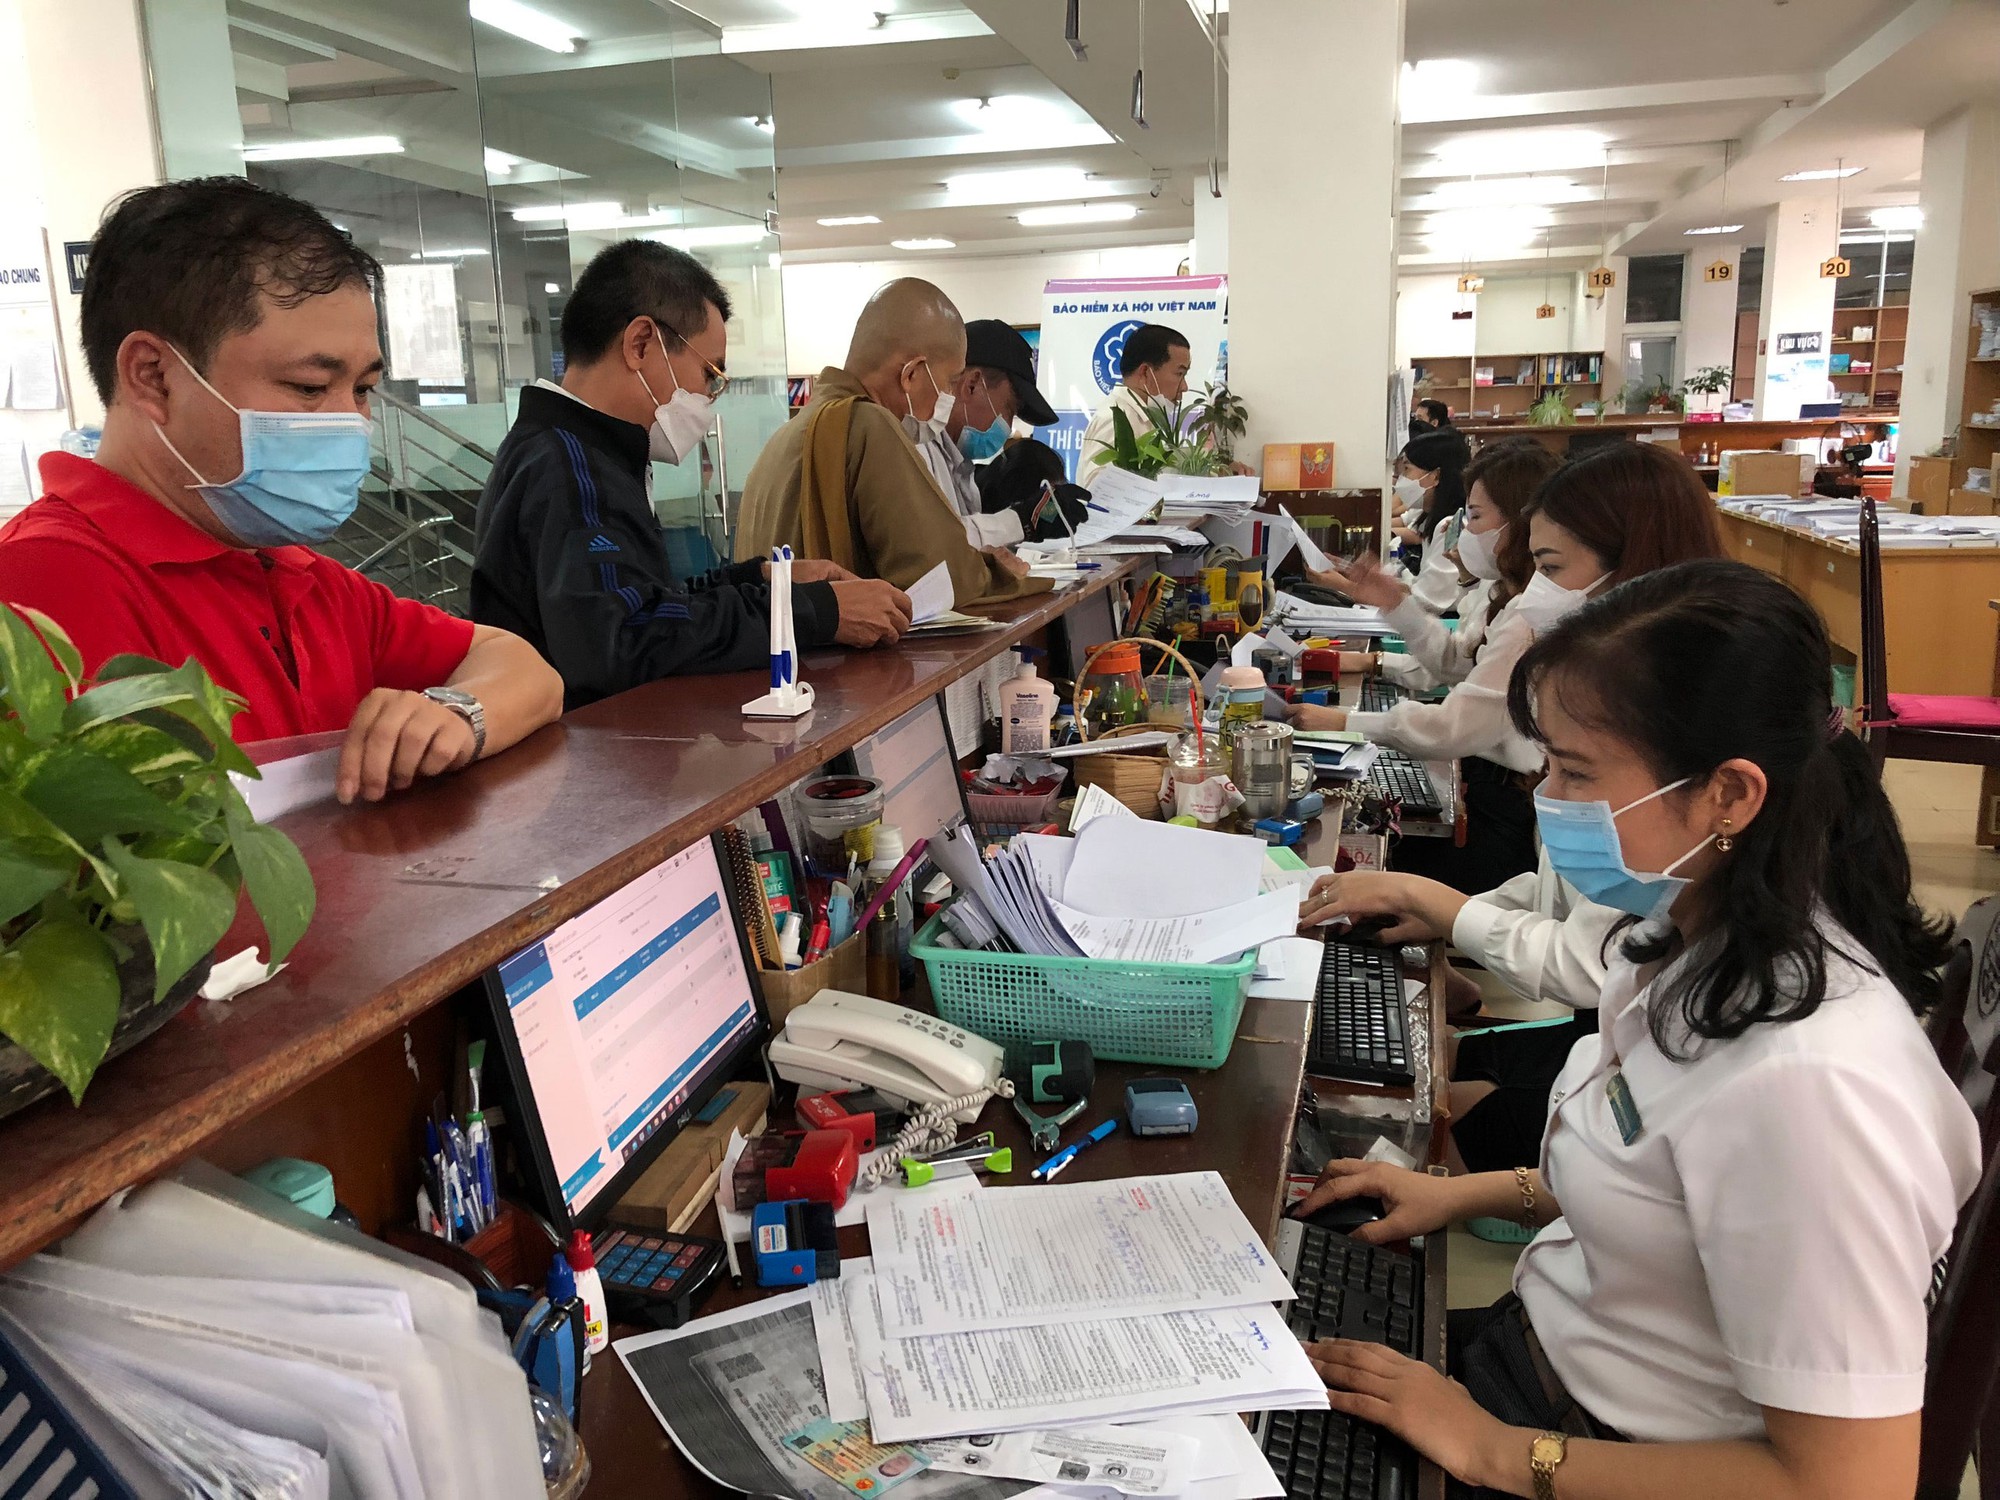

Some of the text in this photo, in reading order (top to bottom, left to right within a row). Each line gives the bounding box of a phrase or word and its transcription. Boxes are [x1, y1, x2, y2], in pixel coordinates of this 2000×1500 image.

[11, 267, 41, 284] CHUNG
[1708, 266, 1729, 279] 19
[1826, 262, 1846, 276] 20
[1593, 273, 1611, 285] 18
[1157, 300, 1185, 314] VIỆT
[1188, 300, 1216, 312] NAM
[1540, 307, 1552, 318] 31
[1074, 432, 1084, 449] Đ
